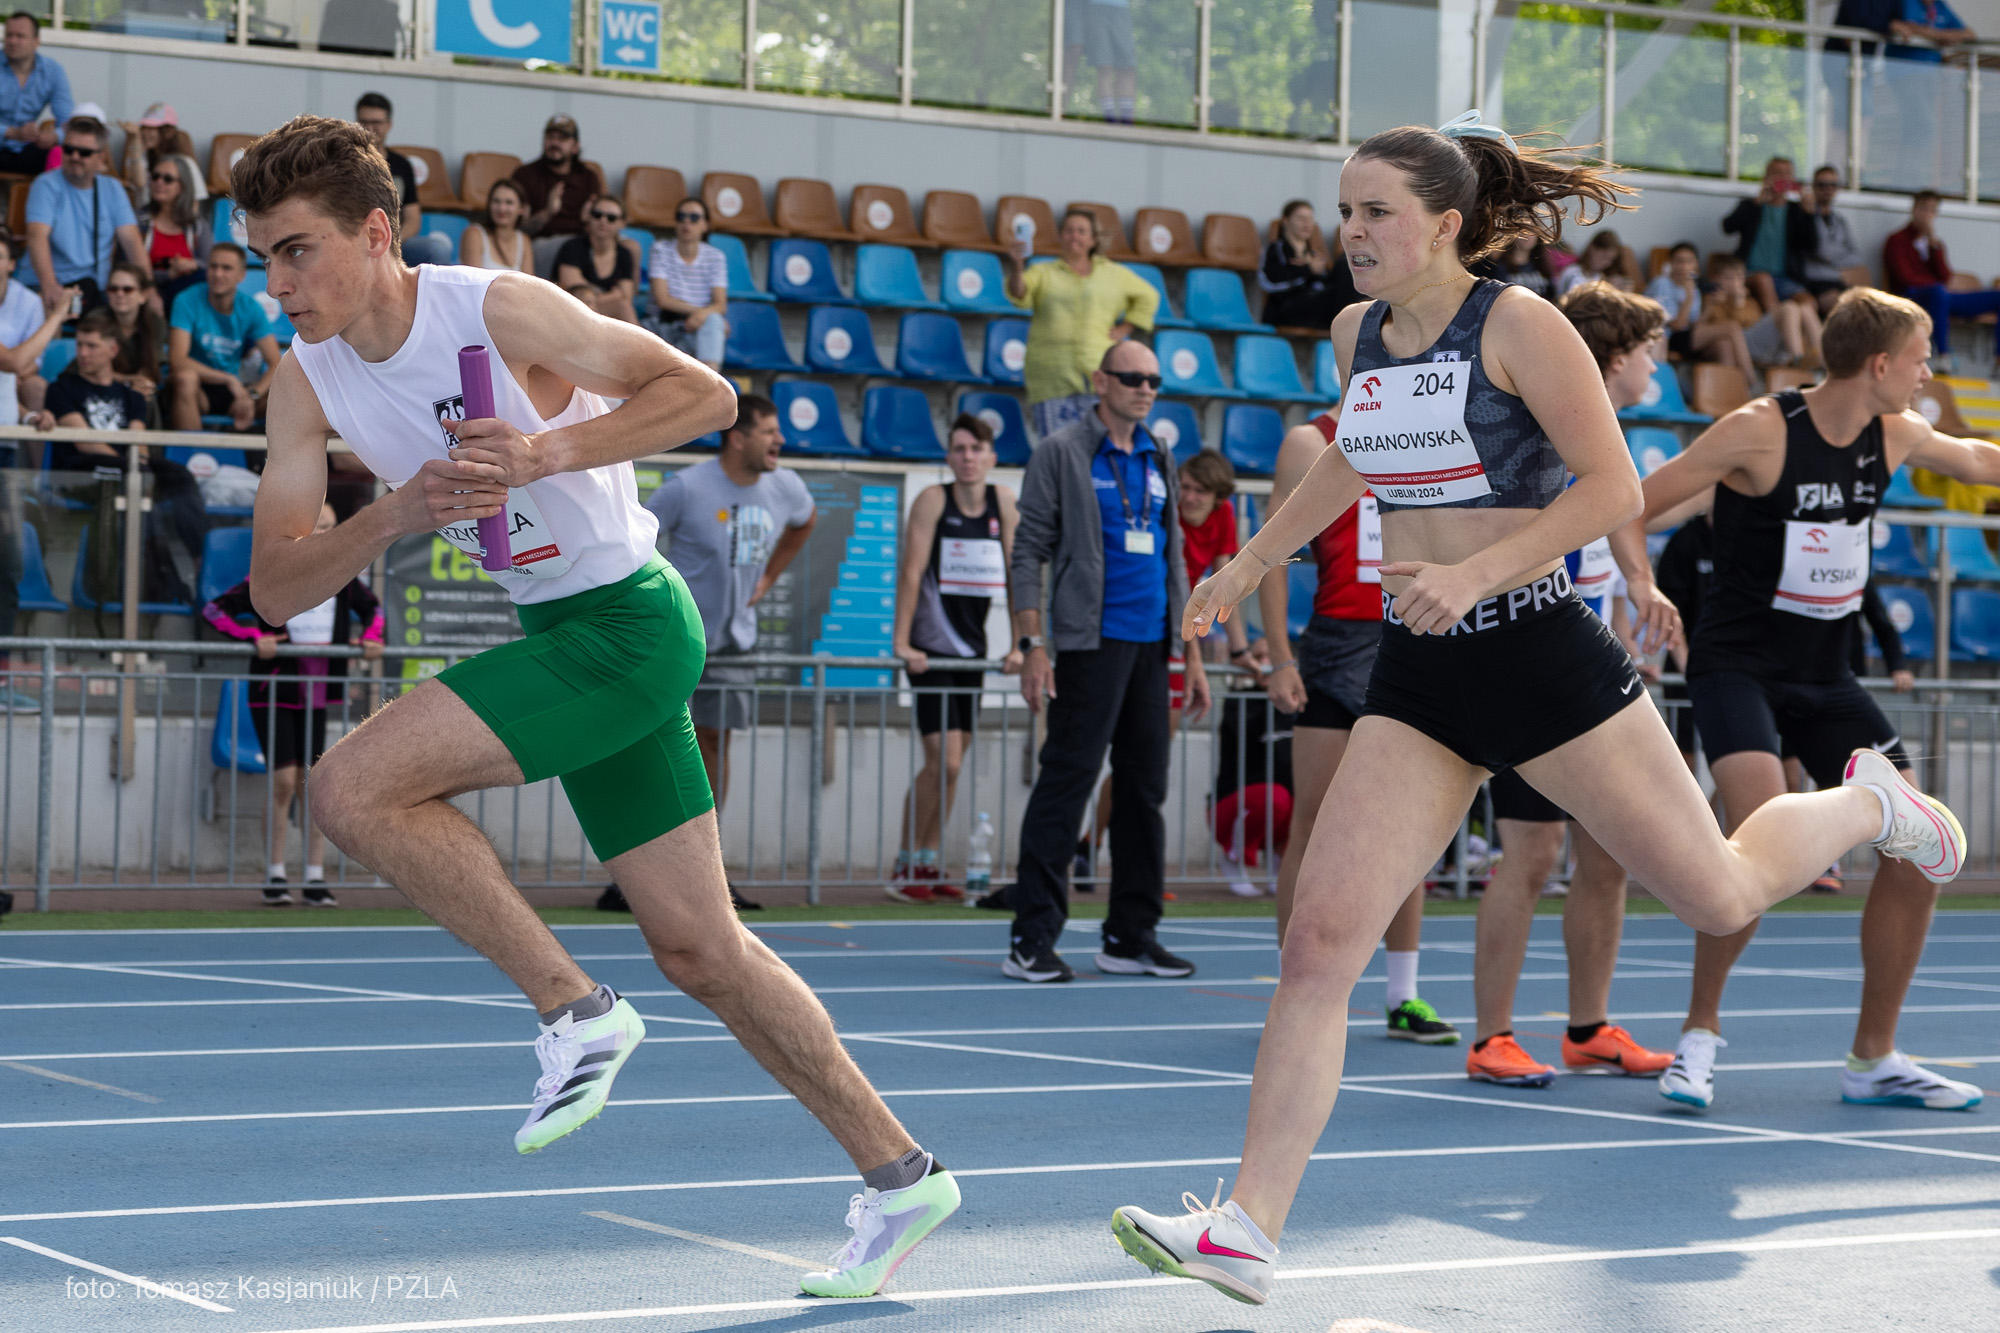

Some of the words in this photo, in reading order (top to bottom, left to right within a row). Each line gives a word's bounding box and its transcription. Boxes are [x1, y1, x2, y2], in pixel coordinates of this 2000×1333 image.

[606, 9, 656, 43] WC
[1413, 372, 1455, 396] 204
[1353, 401, 1382, 412] ORLEN
[1342, 429, 1465, 453] BARANOWSKA
[1442, 467, 1479, 478] MIESZANYCH
[1387, 488, 1417, 499] LUBLIN
[1418, 487, 1444, 498] 2024
[526, 548, 556, 560] MIESZANYCH
[1810, 567, 1860, 583] ŁYSIAK
[1508, 566, 1571, 621] PRO
